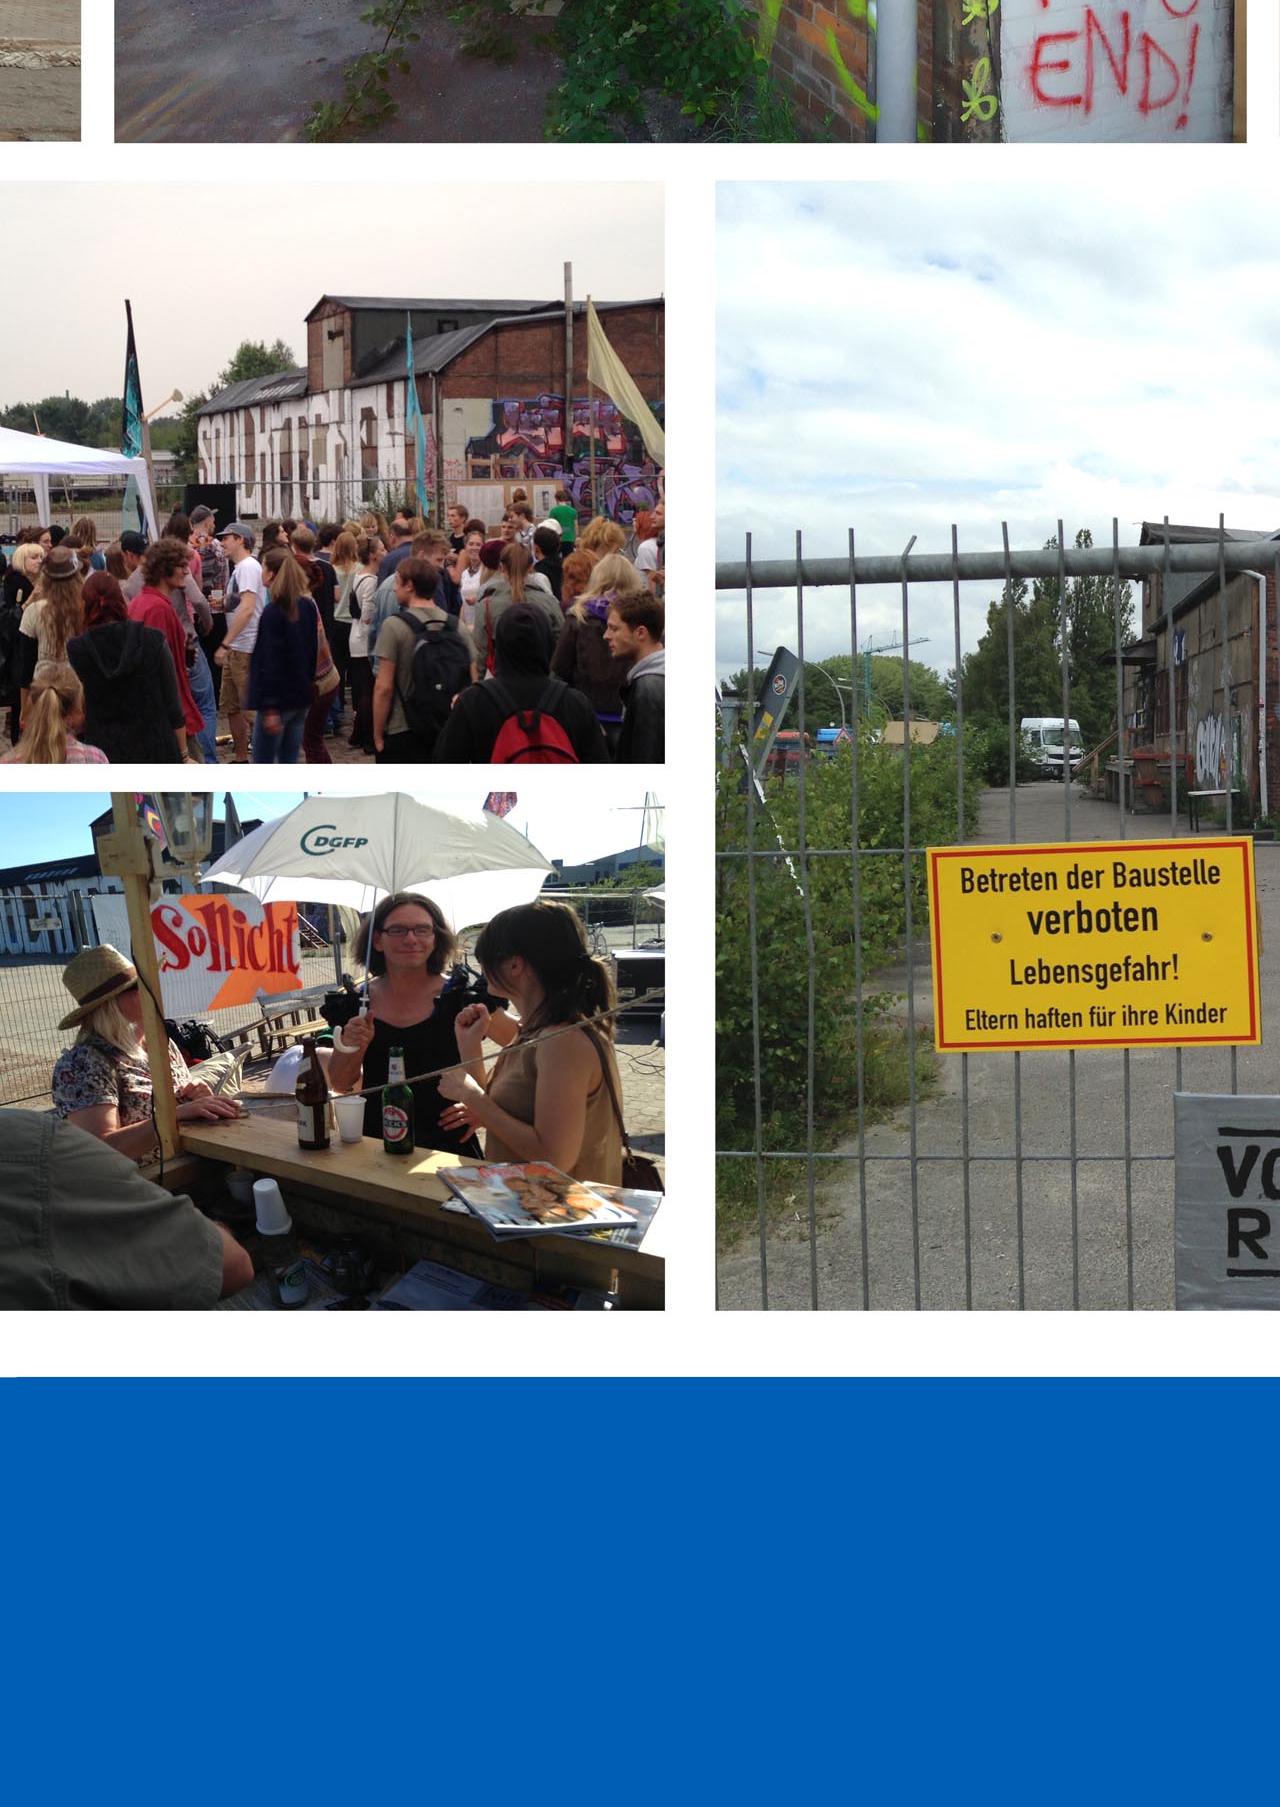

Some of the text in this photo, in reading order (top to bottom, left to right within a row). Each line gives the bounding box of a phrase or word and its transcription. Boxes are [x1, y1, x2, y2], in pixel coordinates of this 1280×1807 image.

[1026, 4, 1200, 130] END!
[960, 858, 1221, 894] Betreten der Baustelle
[1027, 900, 1159, 935] verboten
[1010, 953, 1179, 990] Lebensgefahr!
[965, 1002, 1228, 1031] Eltern haften für ihre Kinder
